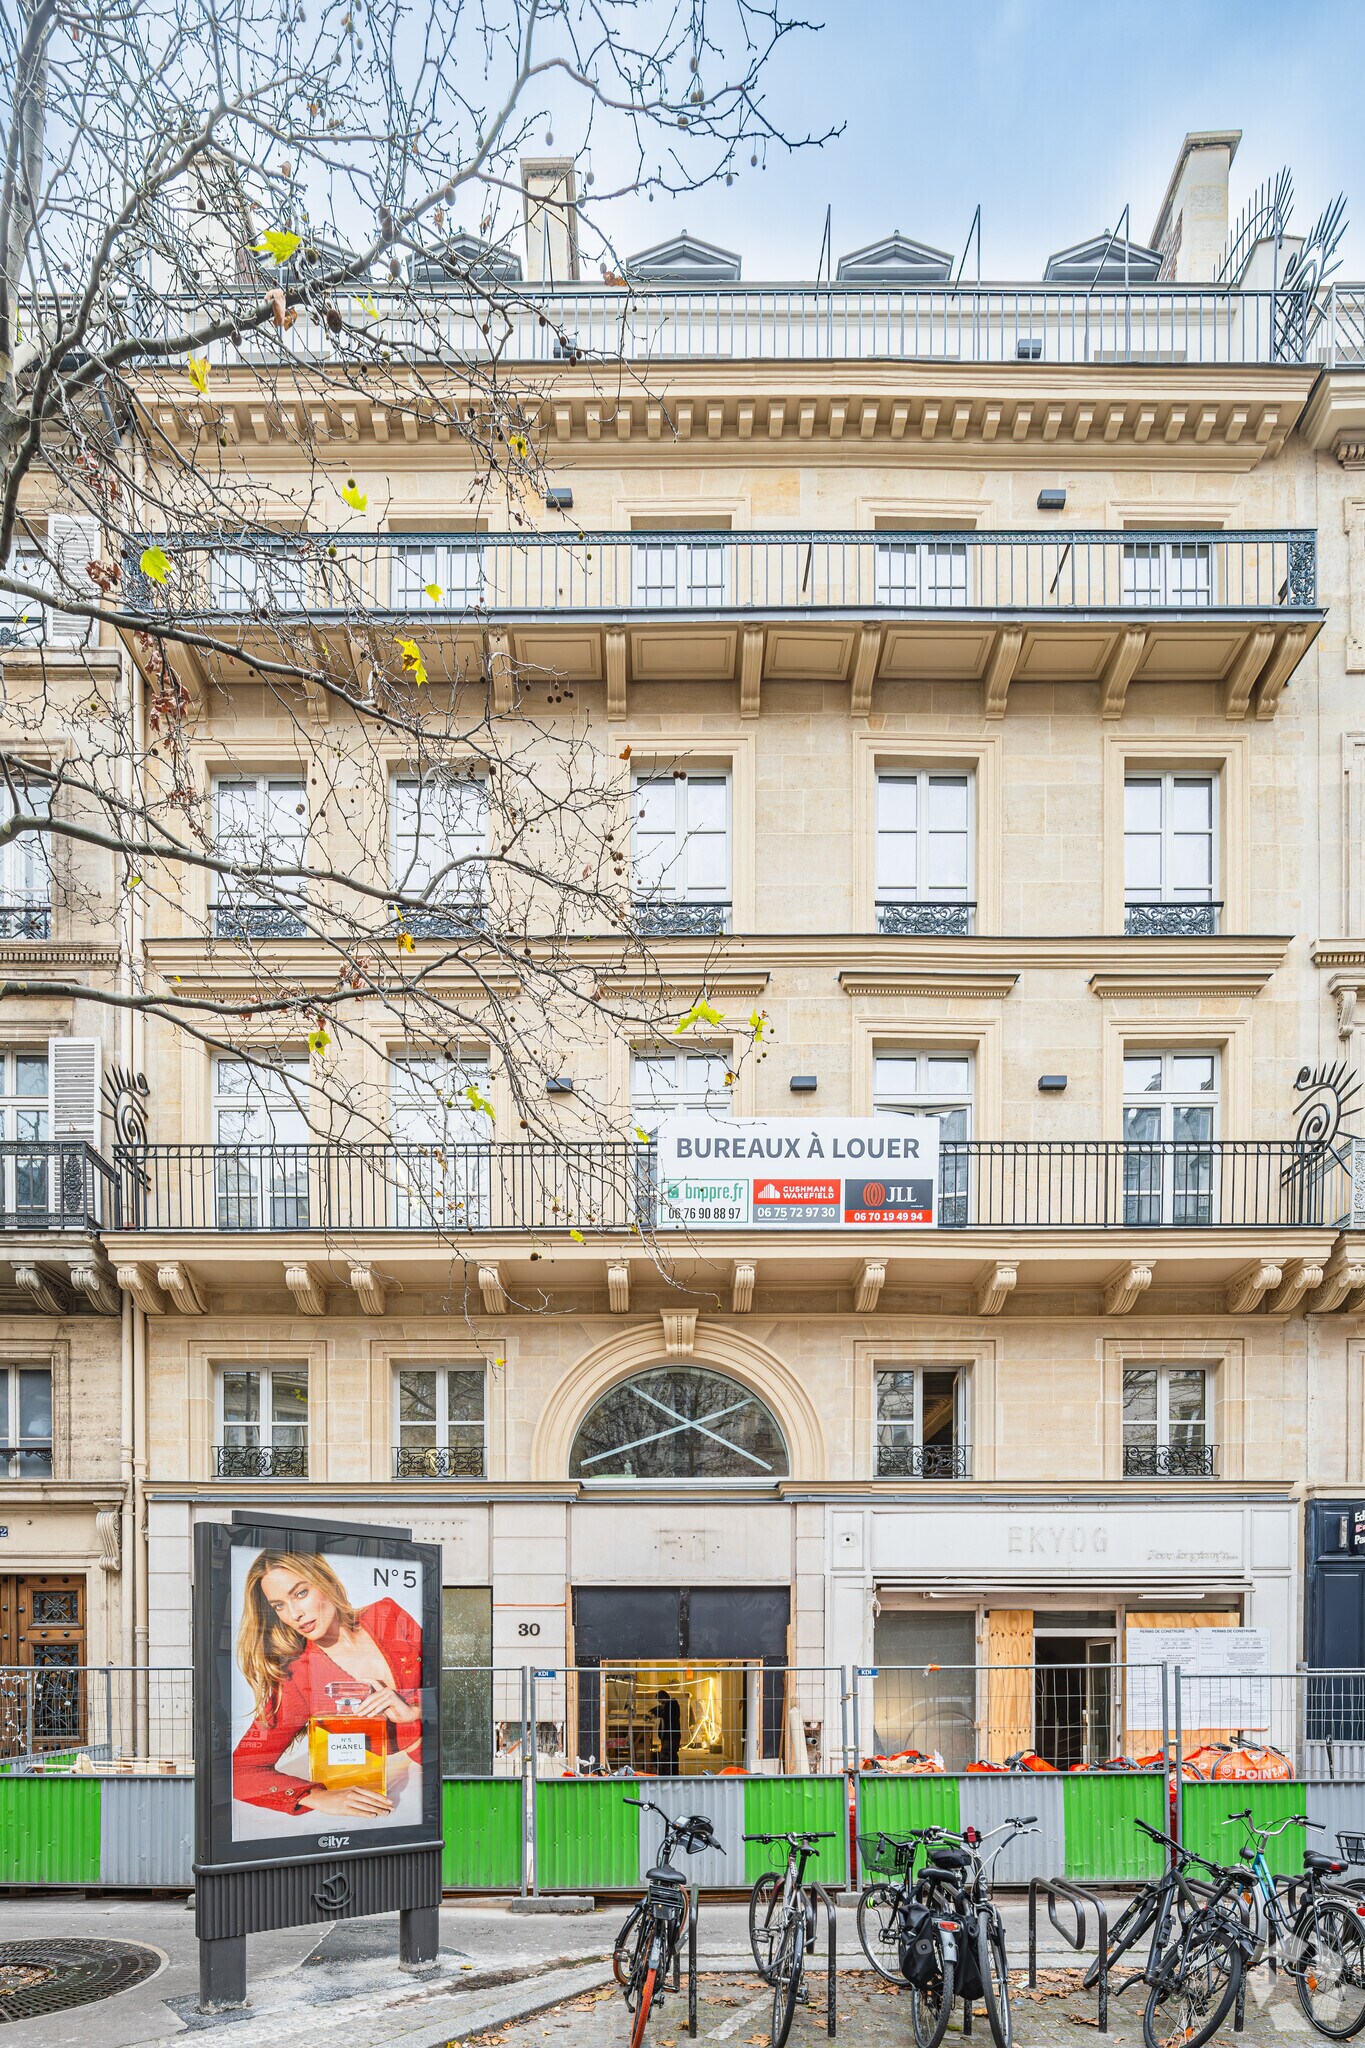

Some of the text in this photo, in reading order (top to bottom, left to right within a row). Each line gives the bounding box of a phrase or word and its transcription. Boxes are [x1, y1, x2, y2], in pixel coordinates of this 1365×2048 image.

[676, 1131, 920, 1159] BUREAUX À LOUER
[685, 1182, 744, 1203] bnppre.fr
[782, 1185, 834, 1193] CUSHMAN &
[885, 1186, 917, 1203] JLL
[668, 1207, 741, 1220] 06 76 90 88 97
[757, 1207, 836, 1218] 06 75 72 97 30
[854, 1212, 923, 1221] 06 70 19 49 94
[1008, 1527, 1108, 1553] EKYOG
[518, 1623, 541, 1636] 30
[330, 1743, 363, 1751] CHANEL
[317, 1835, 350, 1849] Cityz
